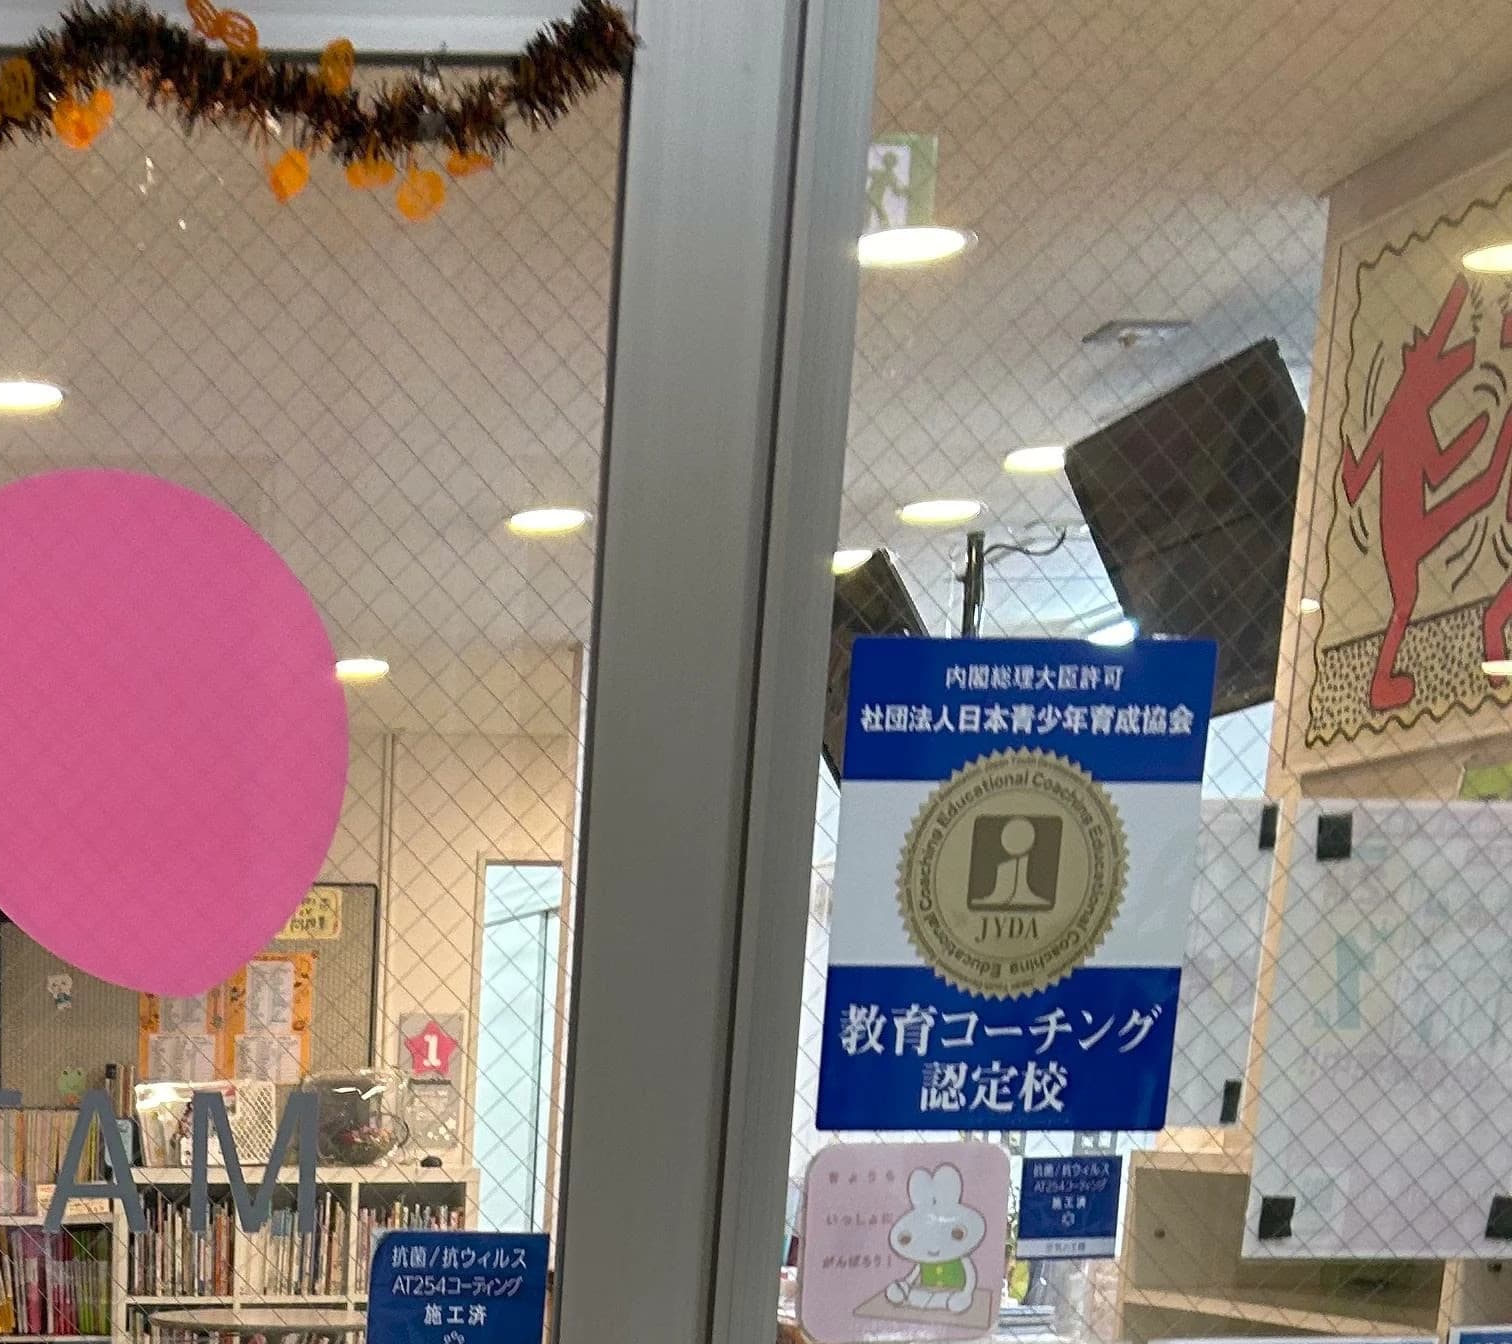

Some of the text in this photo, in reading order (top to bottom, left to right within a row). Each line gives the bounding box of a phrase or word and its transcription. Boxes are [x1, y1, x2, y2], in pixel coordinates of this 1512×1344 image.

[945, 663, 1124, 691] 内閣総理大臣許可
[860, 702, 1194, 735] 社団法人日本青少年育成協会
[974, 915, 1039, 944] JYDA
[841, 1001, 1164, 1057] 教育コーチング
[422, 1034, 441, 1068] 1
[920, 1060, 1069, 1114] 認定校
[392, 1275, 523, 1297] AT254コーティング
[424, 1303, 488, 1326] 施工済
